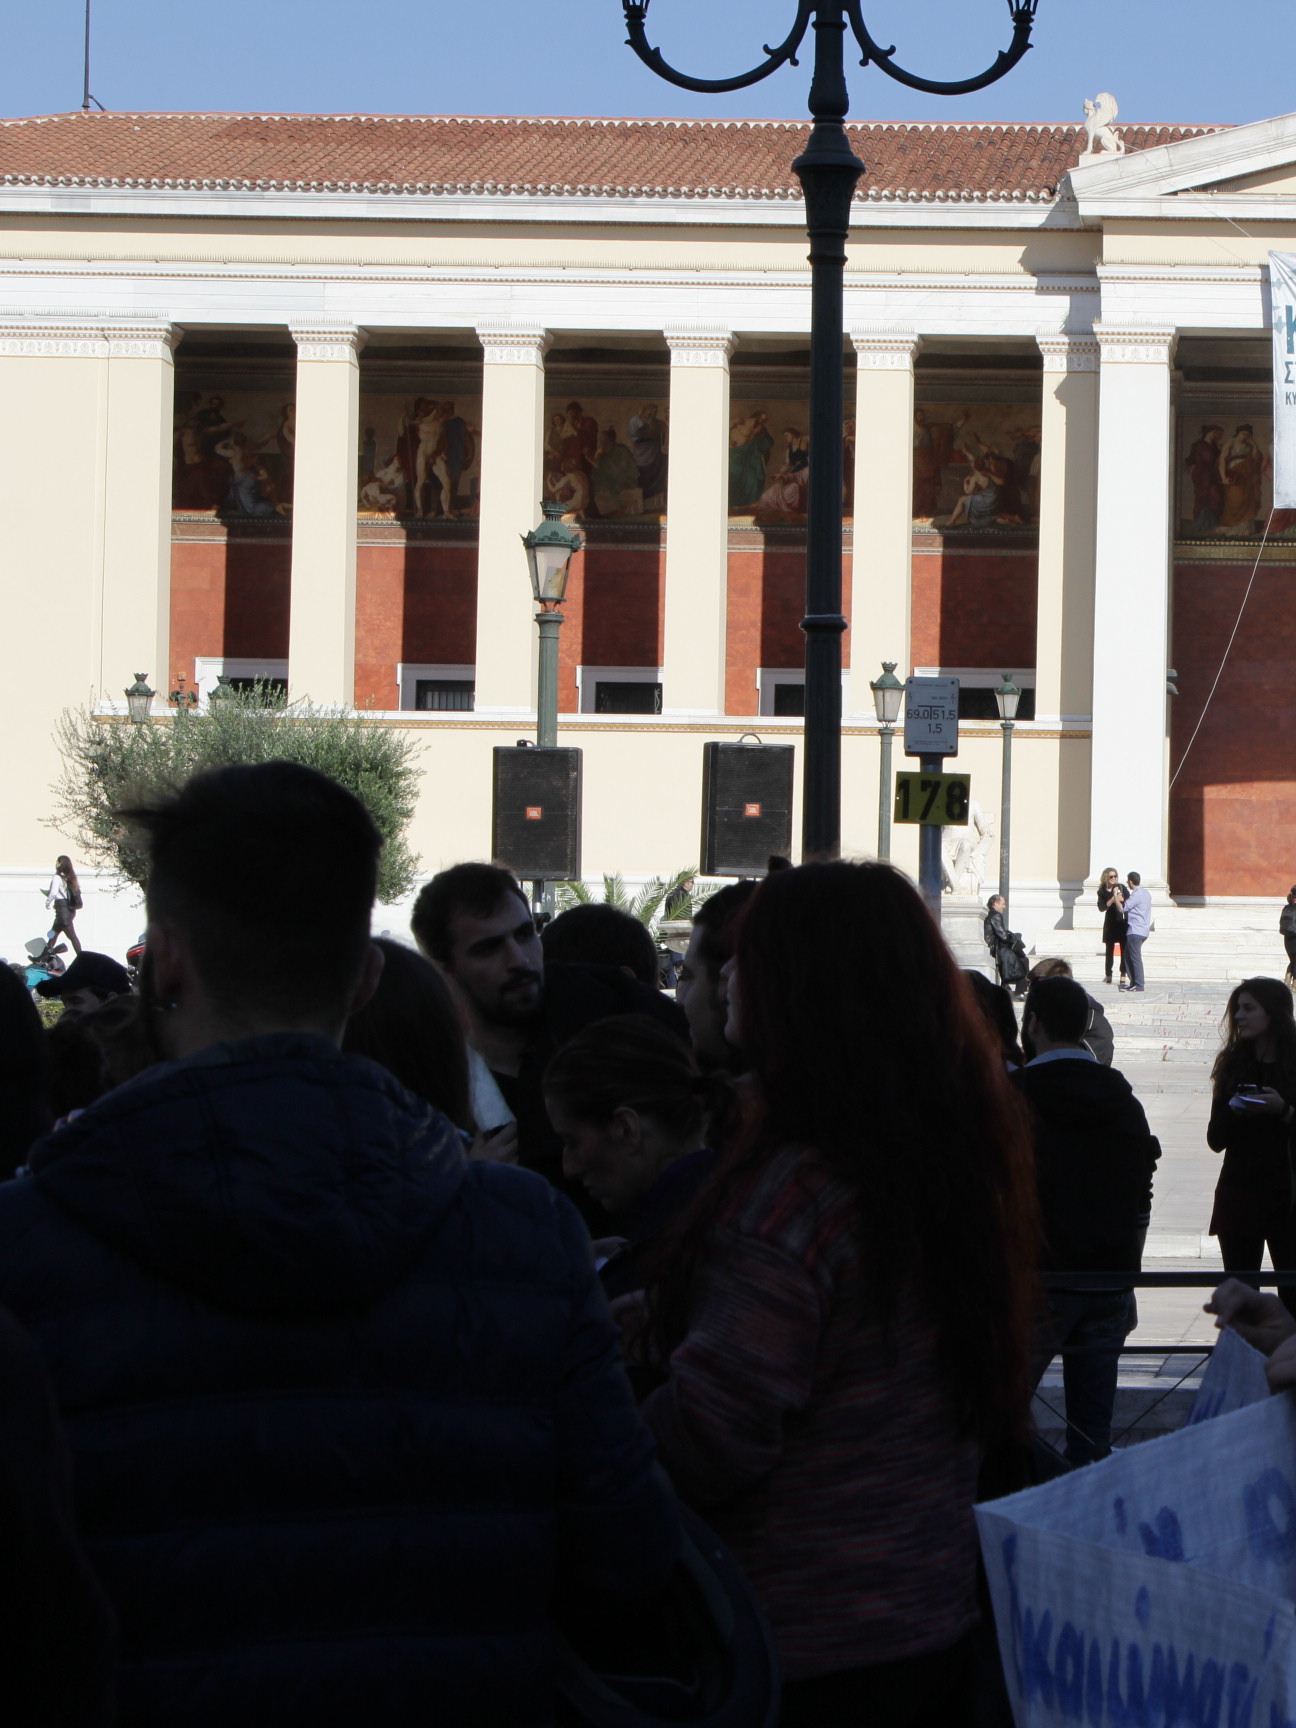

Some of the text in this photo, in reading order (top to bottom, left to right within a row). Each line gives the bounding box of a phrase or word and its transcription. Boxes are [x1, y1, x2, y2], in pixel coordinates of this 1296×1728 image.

[907, 709, 956, 720] 69.0 51.5
[928, 723, 943, 733] 1.5
[898, 778, 968, 821] 178
